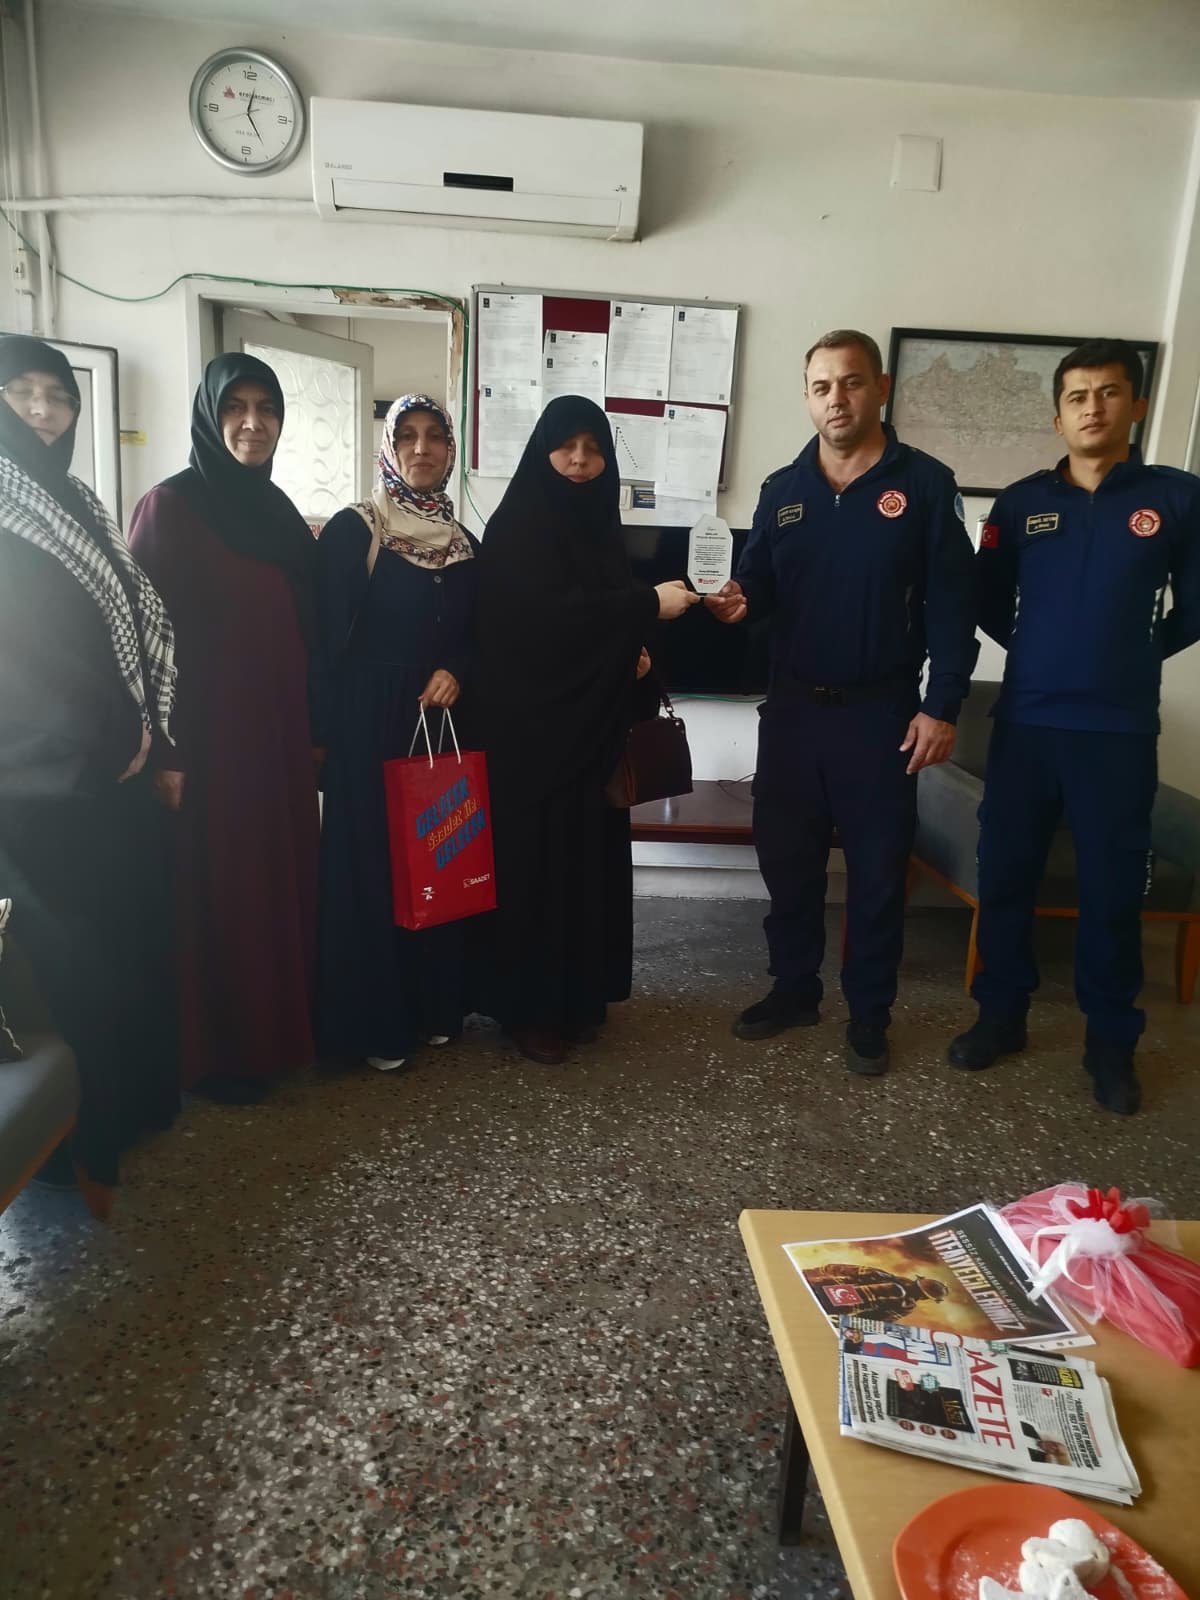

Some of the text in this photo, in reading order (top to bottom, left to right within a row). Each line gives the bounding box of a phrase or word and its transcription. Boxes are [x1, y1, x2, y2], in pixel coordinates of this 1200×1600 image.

[243, 70, 257, 81] 12
[208, 103, 219, 112] 9
[278, 115, 287, 124] 3
